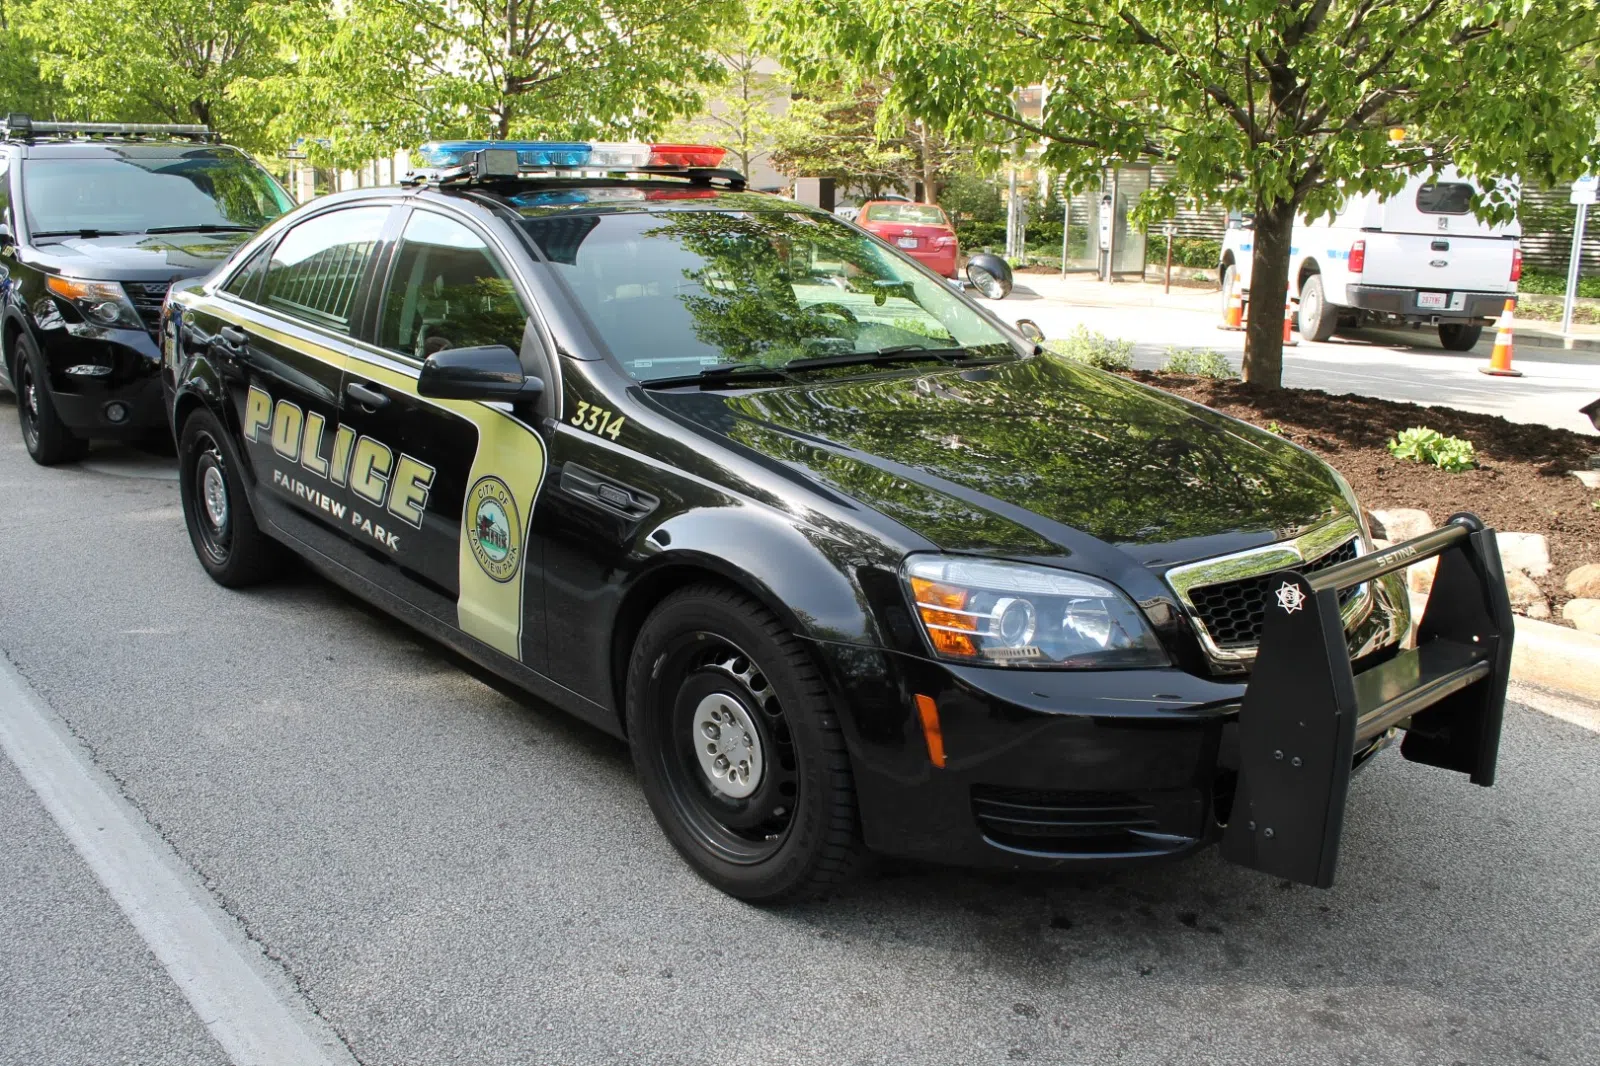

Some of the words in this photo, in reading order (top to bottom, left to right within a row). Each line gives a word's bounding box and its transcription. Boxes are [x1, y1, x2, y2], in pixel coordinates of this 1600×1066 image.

[571, 400, 625, 440] 3314
[244, 385, 437, 530] POLICE
[273, 469, 347, 519] FAIRVIEW
[352, 511, 401, 551] PARK
[477, 484, 495, 499] CITY
[498, 490, 509, 506] OF
[470, 528, 502, 575] FAIRVIEW
[503, 547, 517, 573] PARK
[1376, 545, 1417, 568] SETINA
